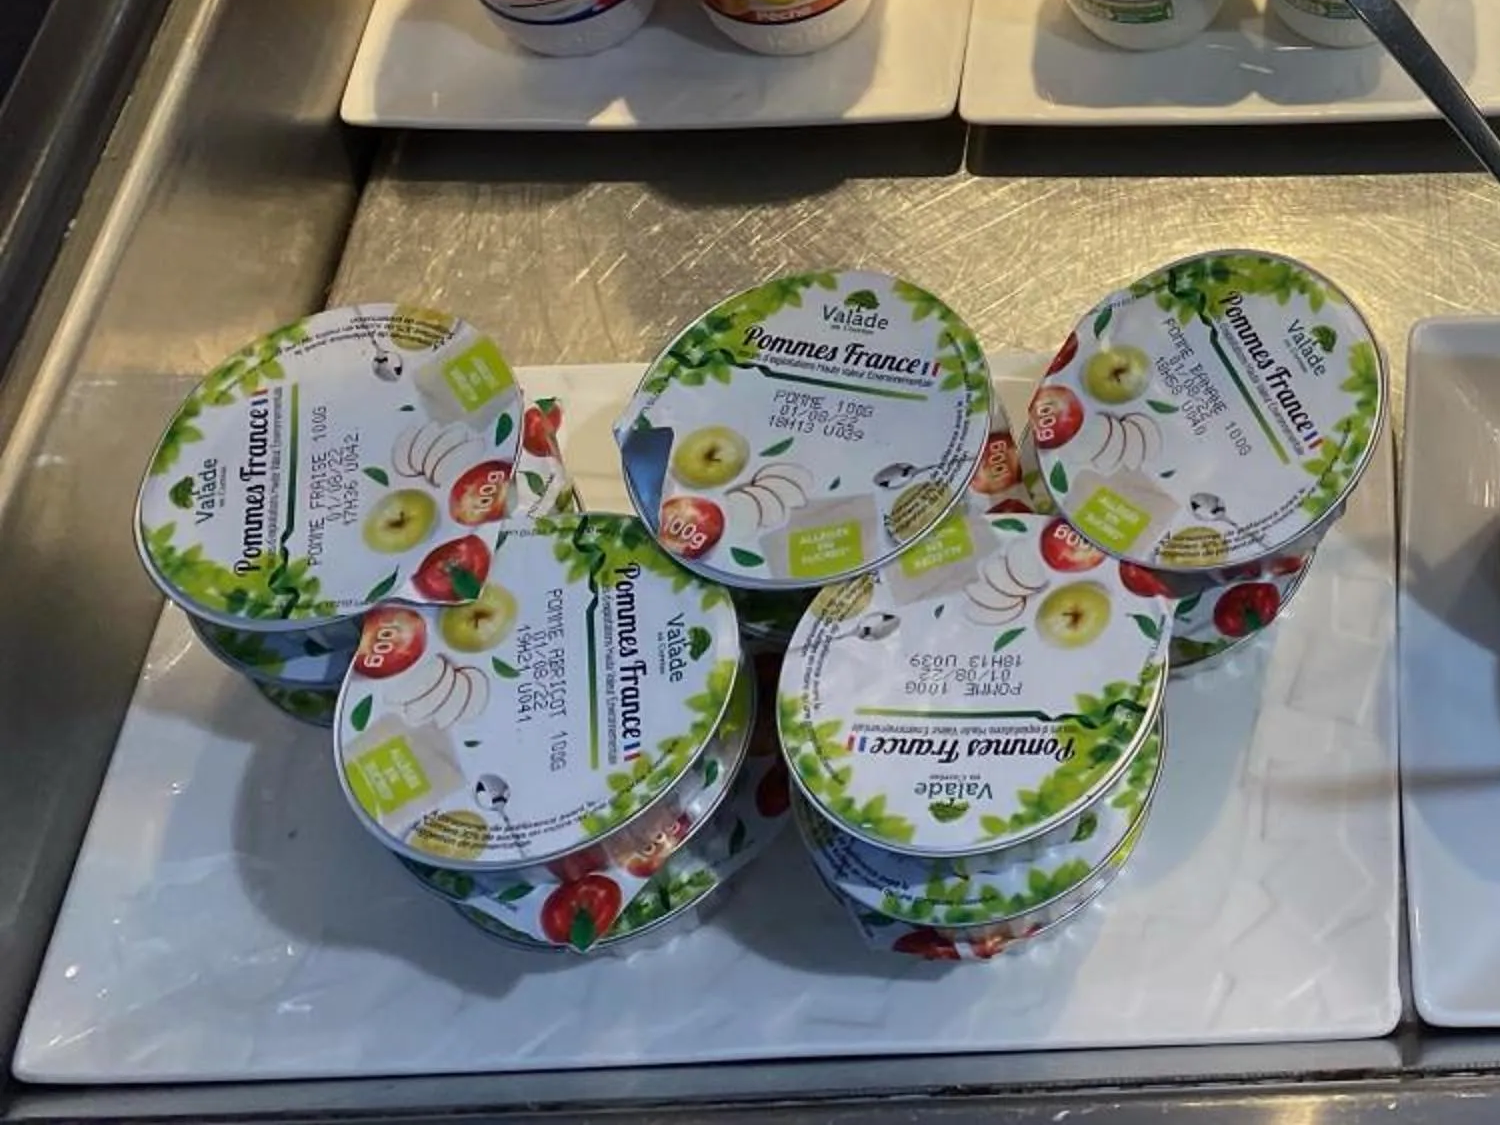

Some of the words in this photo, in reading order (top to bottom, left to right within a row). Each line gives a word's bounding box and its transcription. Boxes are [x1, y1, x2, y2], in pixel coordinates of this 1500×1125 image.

[821, 304, 889, 332] Valade
[743, 326, 839, 363] Pommes
[844, 342, 921, 375] France
[1219, 290, 1275, 369] Pommes
[1266, 365, 1315, 434] France
[1286, 319, 1327, 378] Valade
[240, 406, 269, 482] France
[194, 458, 219, 527] Valade
[309, 453, 327, 510] FRAISE
[234, 483, 269, 577] Pommes
[614, 563, 641, 664] Pommes
[666, 612, 689, 683] Valade
[617, 662, 648, 739] France
[963, 682, 1023, 697] POMME
[870, 737, 960, 764] France
[967, 737, 1077, 763] Pommes
[914, 781, 993, 800] Valade
